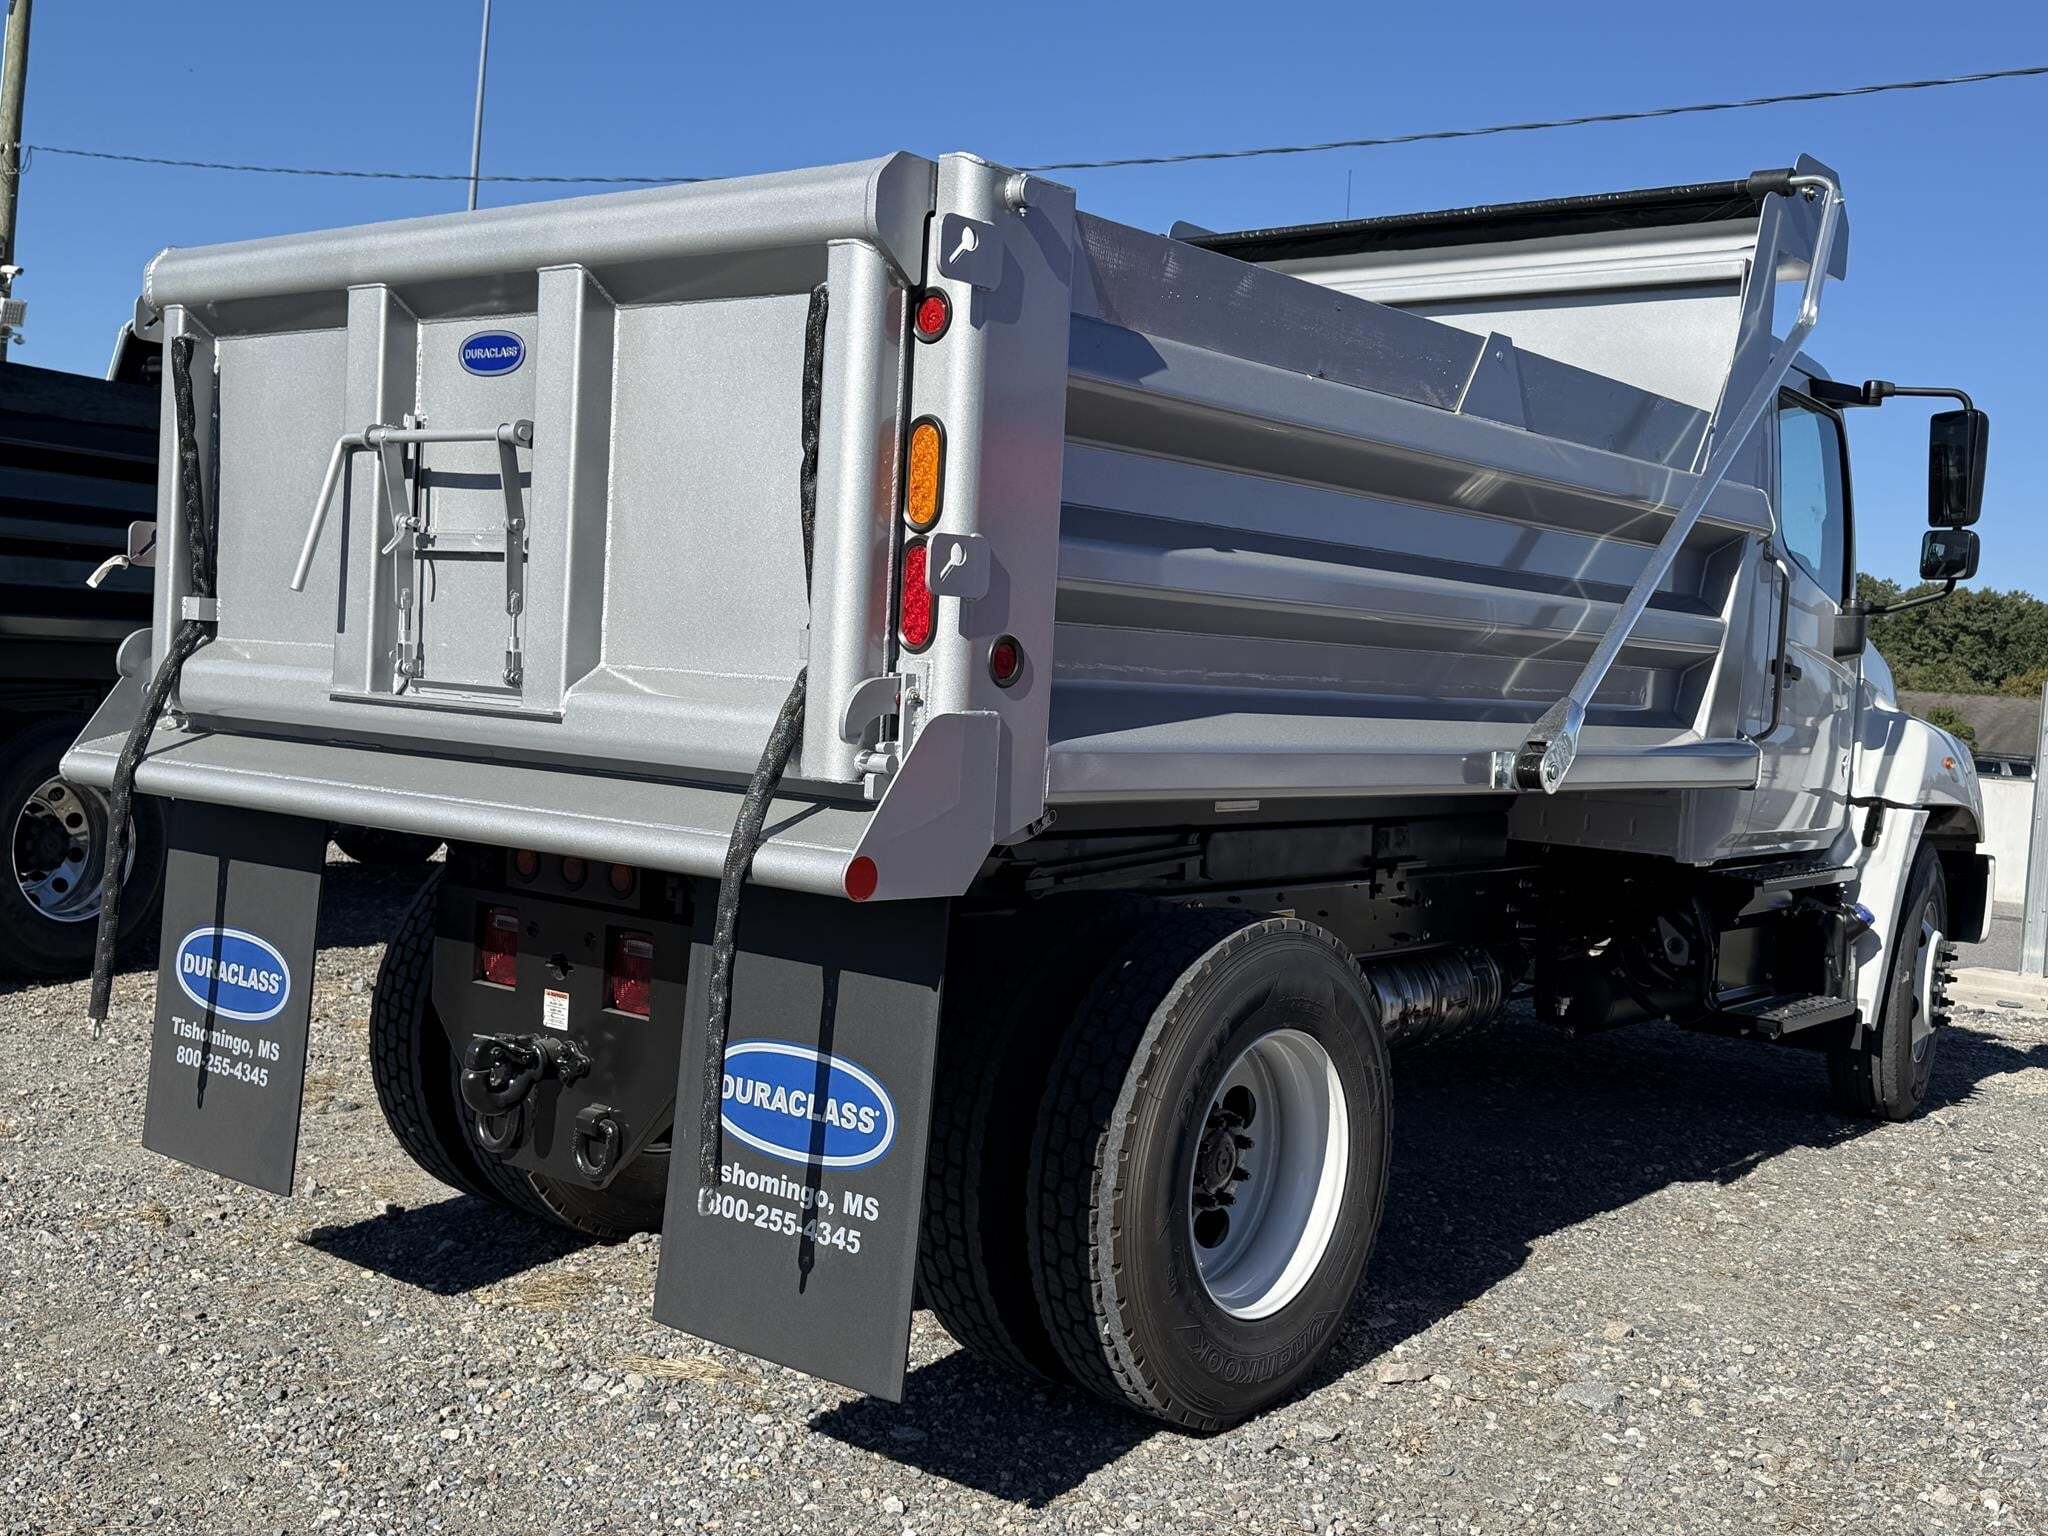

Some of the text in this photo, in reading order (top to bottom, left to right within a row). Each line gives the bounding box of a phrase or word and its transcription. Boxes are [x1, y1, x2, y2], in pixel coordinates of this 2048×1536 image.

[465, 346, 517, 360] DURACLASS
[183, 952, 280, 995] DURACLASS
[172, 1016, 280, 1061] Tishomingo, MS
[176, 1045, 269, 1087] 800-255-4345
[721, 1074, 876, 1134] DURACLASS
[721, 1162, 880, 1222] shomingo, MS
